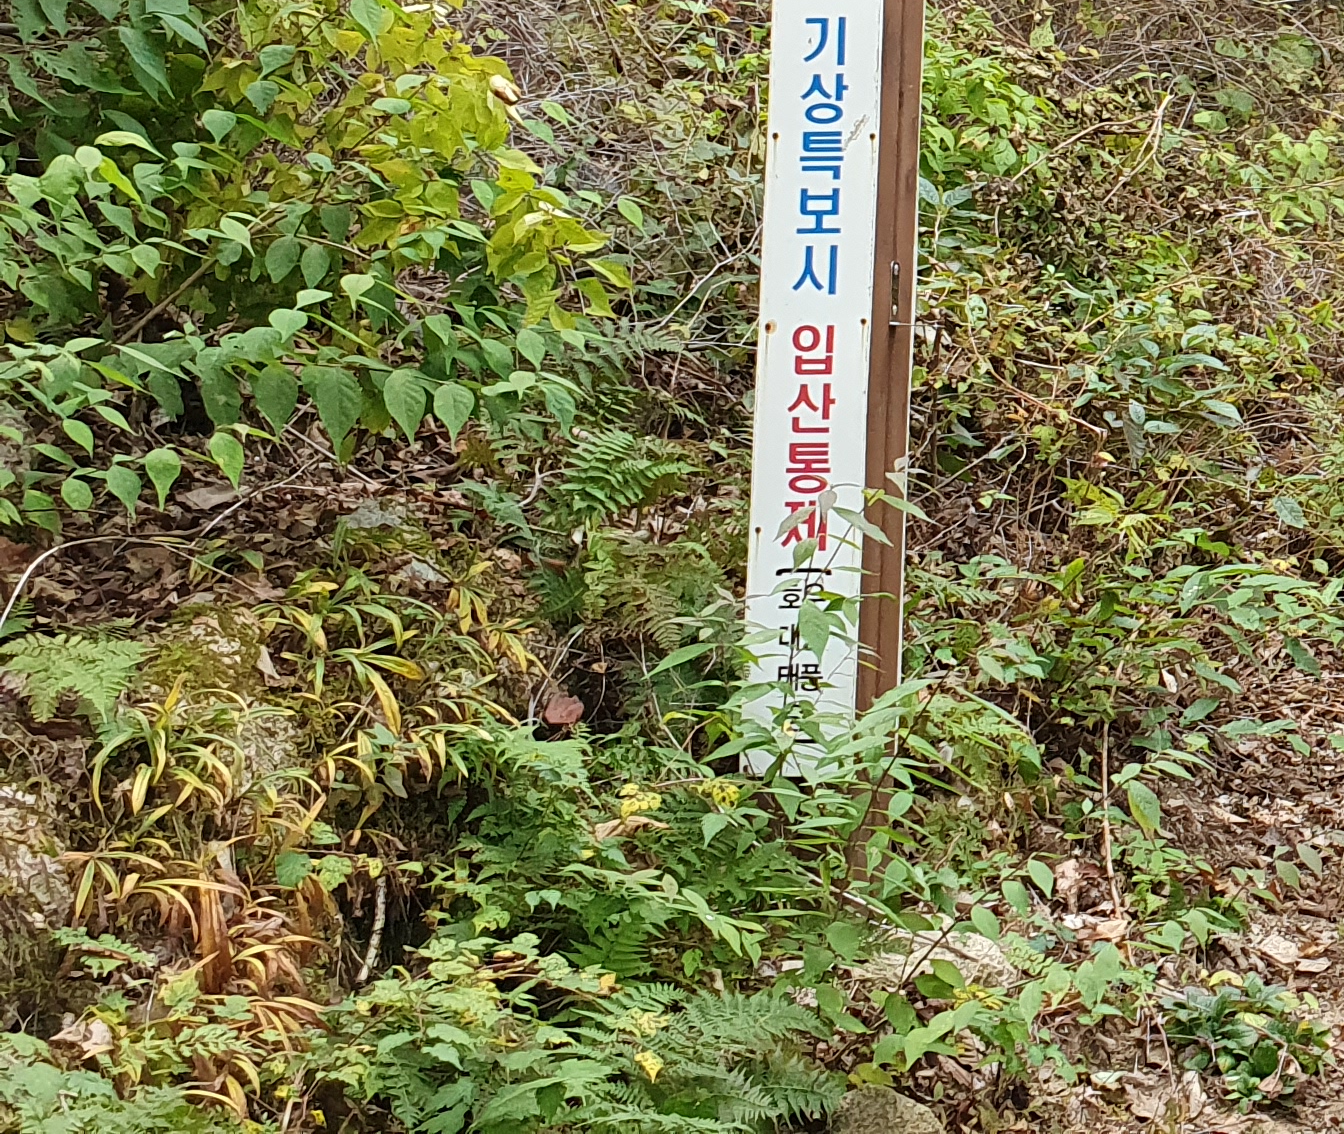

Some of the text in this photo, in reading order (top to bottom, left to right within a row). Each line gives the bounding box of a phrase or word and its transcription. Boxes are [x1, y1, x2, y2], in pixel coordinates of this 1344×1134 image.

[781, 16, 849, 551] 기상특보시 입산통제
[777, 663, 824, 692] 태풍
